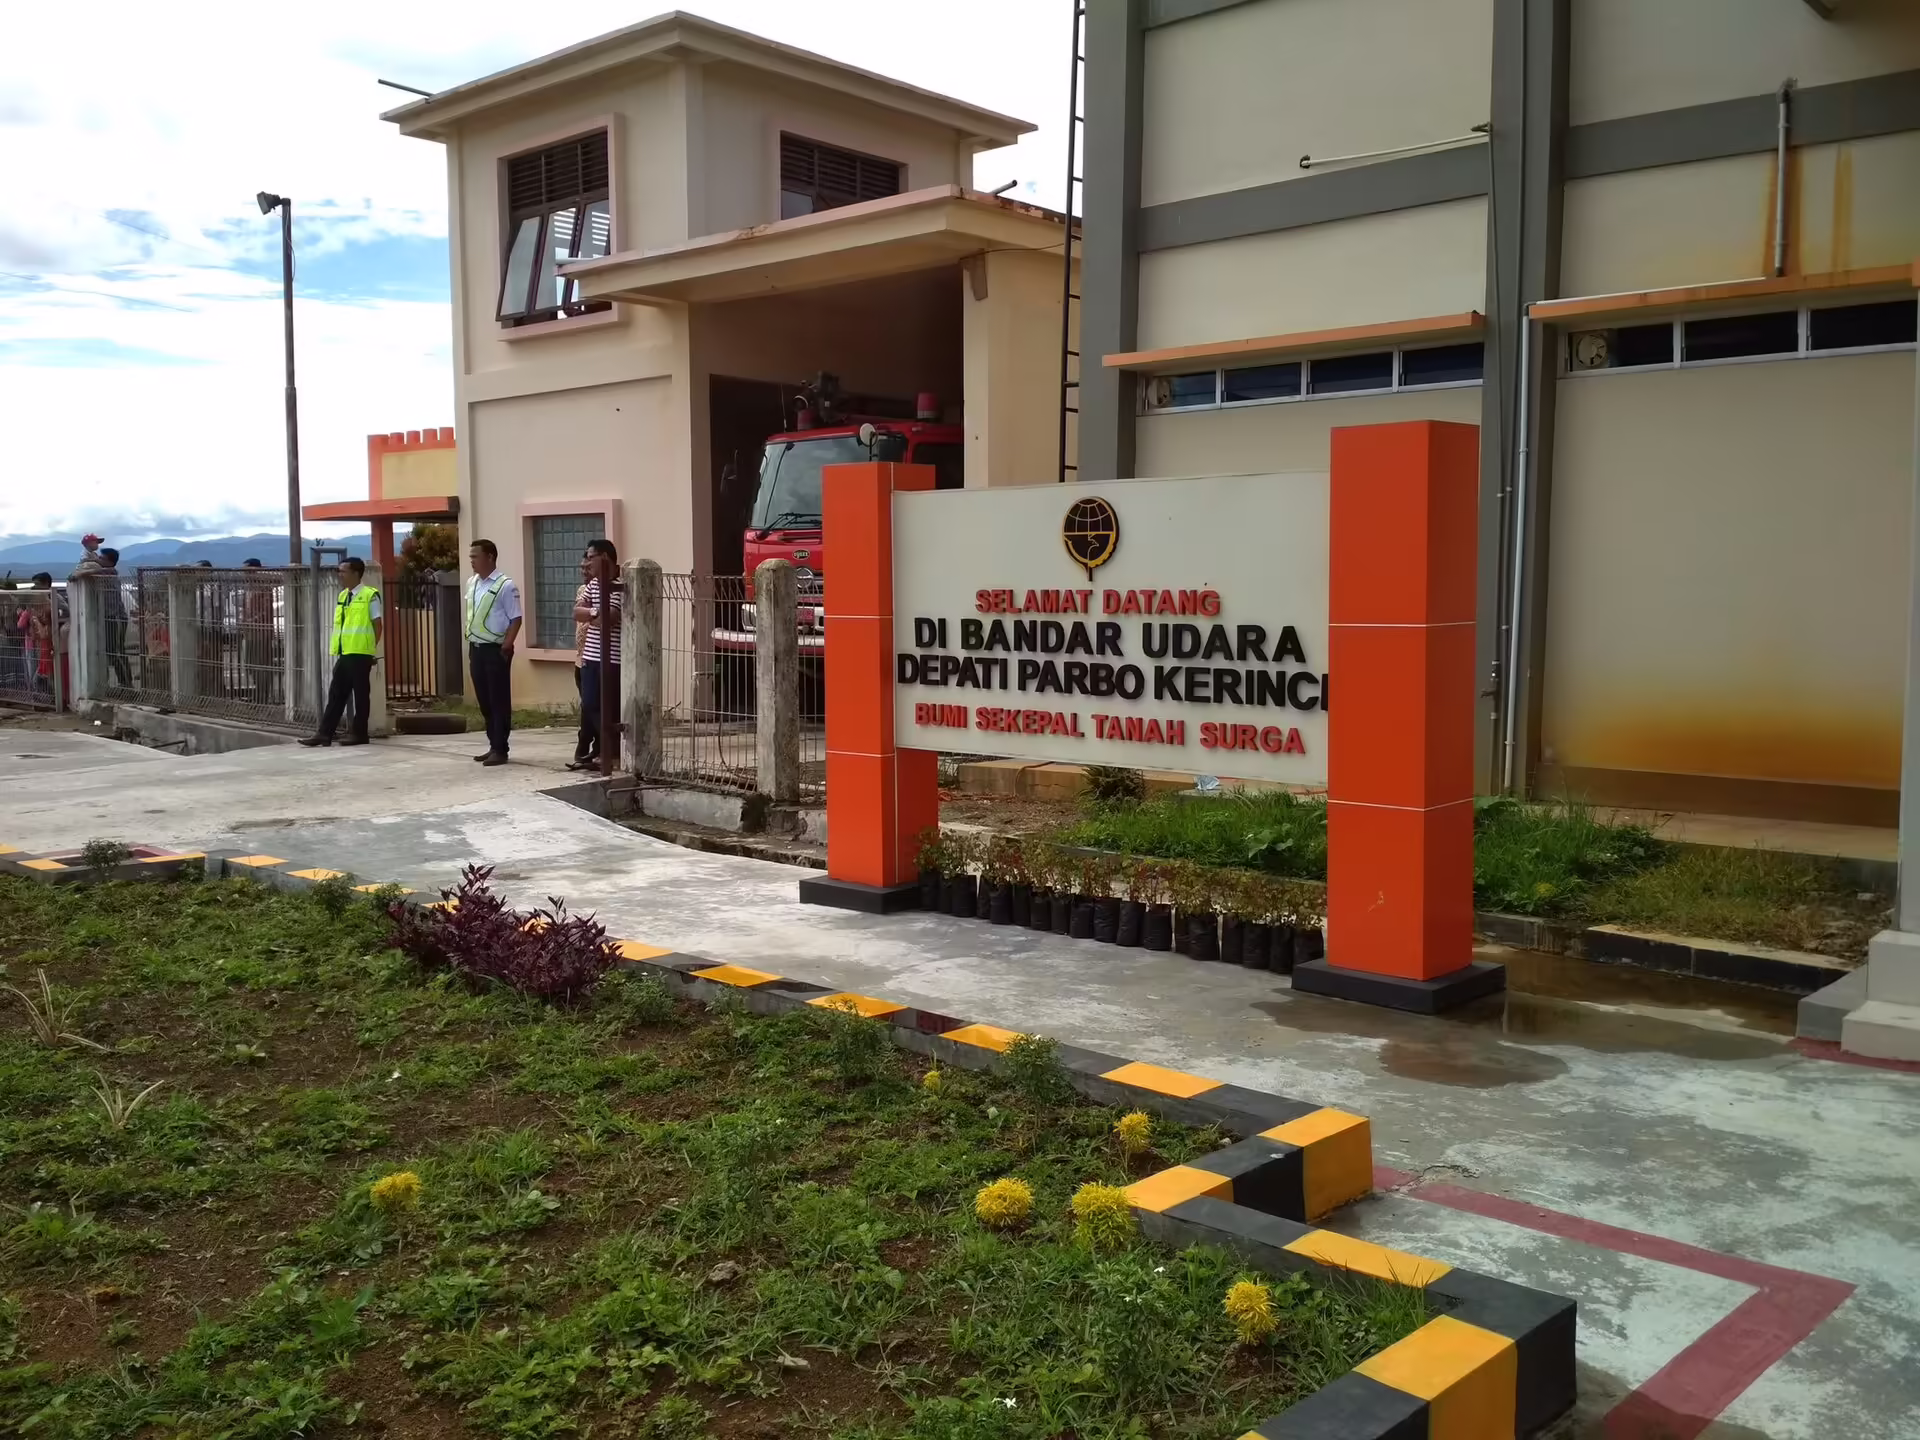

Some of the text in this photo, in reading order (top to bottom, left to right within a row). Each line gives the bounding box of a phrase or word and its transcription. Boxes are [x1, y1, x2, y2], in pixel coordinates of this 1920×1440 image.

[975, 589, 1220, 616] SELAMAT DATANG
[914, 617, 1306, 663] DI BANDAR UDARA
[897, 653, 1328, 711] DEPATI PARBO KERINCI
[914, 703, 1305, 755] BUMI SEKEPAL TANAH SURGA
